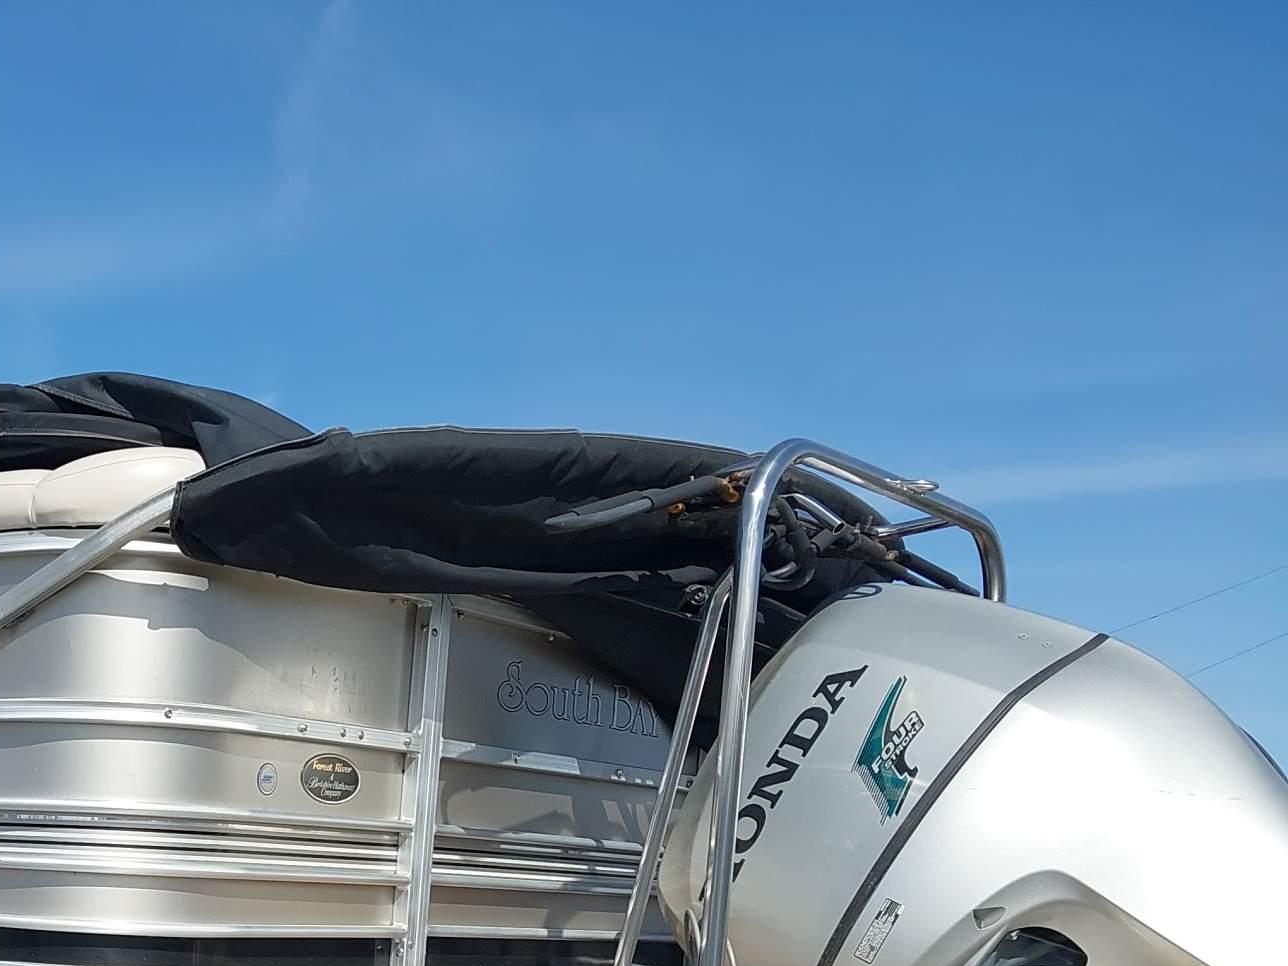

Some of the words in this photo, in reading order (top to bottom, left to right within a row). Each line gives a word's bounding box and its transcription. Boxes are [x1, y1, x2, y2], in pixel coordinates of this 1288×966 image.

[497, 660, 604, 727] South
[312, 760, 333, 772] Forest
[872, 711, 919, 774] FOUR
[884, 720, 923, 770] STROKE
[698, 665, 870, 902] ONDA
